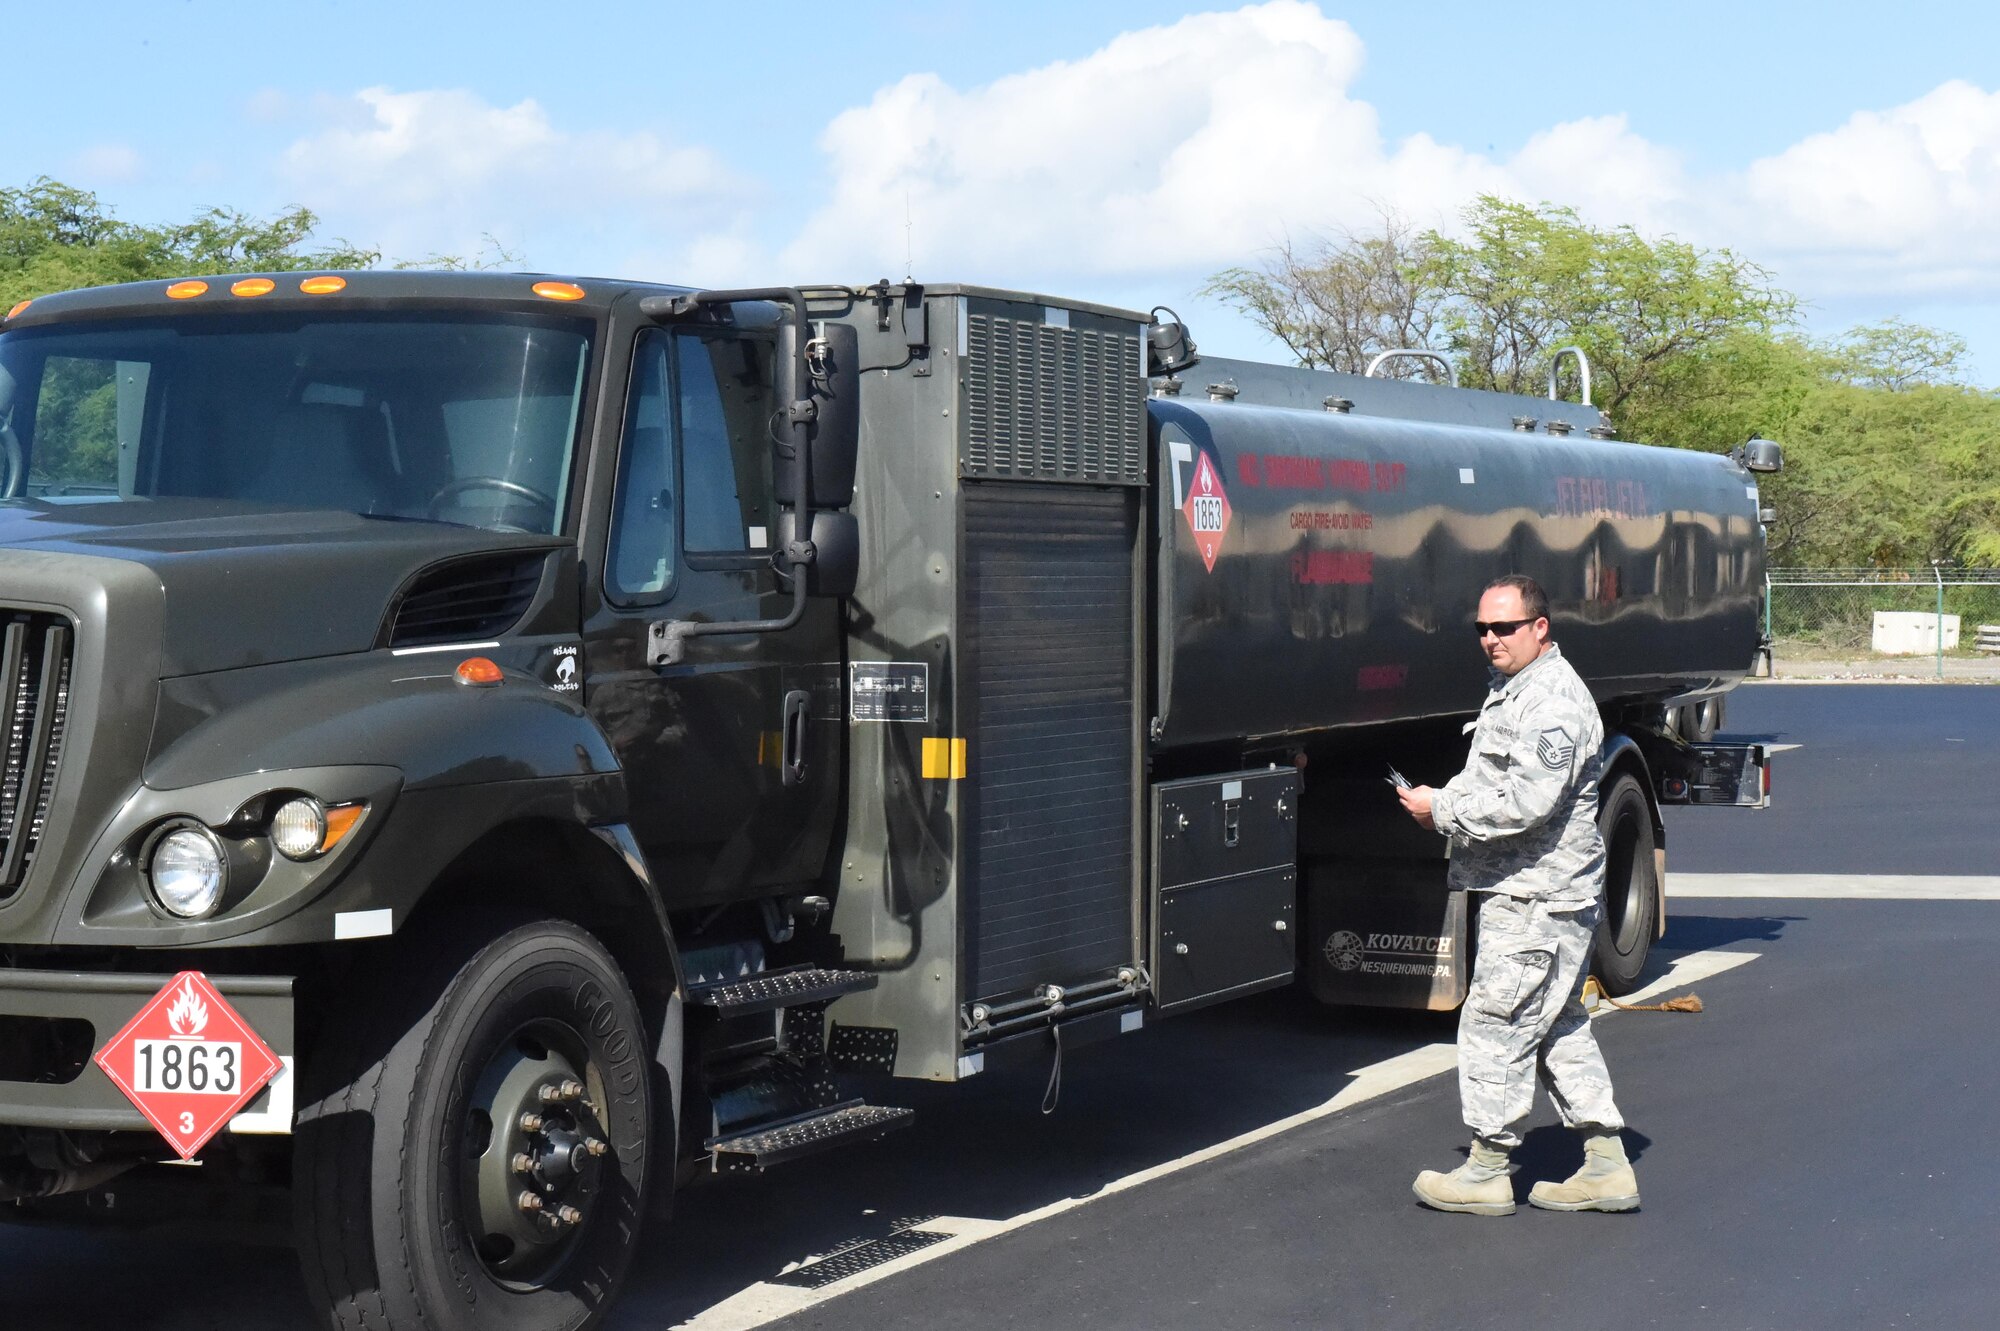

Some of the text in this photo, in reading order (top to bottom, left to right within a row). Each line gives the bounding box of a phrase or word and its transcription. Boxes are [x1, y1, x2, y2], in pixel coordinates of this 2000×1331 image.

[1194, 498, 1222, 531] 1863
[1290, 512, 1312, 530] CARGO
[1351, 512, 1373, 530] WATER
[1206, 543, 1213, 559] 3
[1365, 933, 1452, 953] KOVATCH
[139, 1043, 236, 1092] 1863
[178, 1111, 195, 1135] 3
